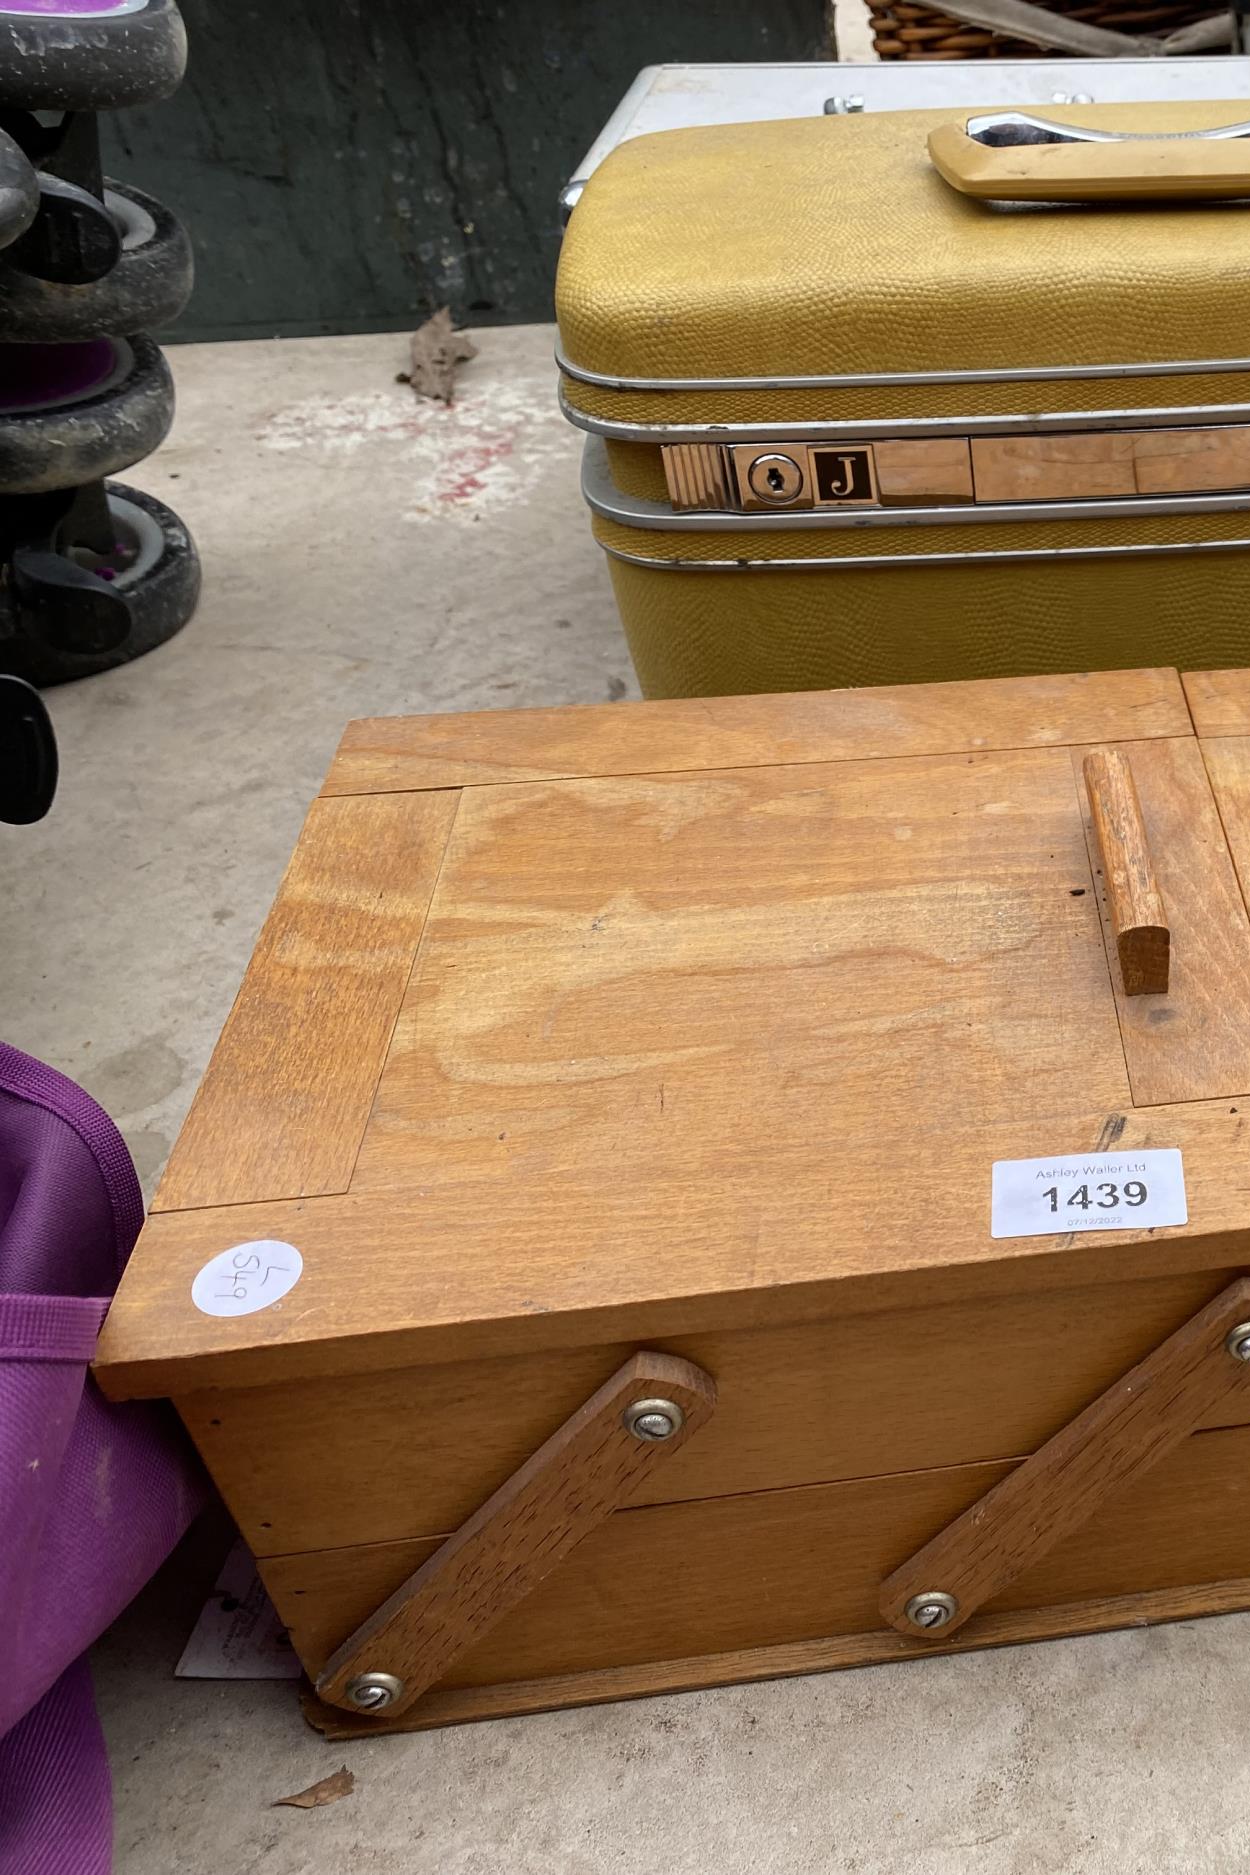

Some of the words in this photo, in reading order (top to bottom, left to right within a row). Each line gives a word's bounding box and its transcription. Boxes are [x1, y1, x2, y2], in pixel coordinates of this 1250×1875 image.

[831, 456, 856, 496] J
[1035, 1167, 1079, 1180] Ashley
[1083, 1164, 1123, 1176] Waller
[1126, 1162, 1147, 1173] Ltd
[1042, 1180, 1149, 1213] 1439
[1066, 1216, 1123, 1227] 07/12/2022
